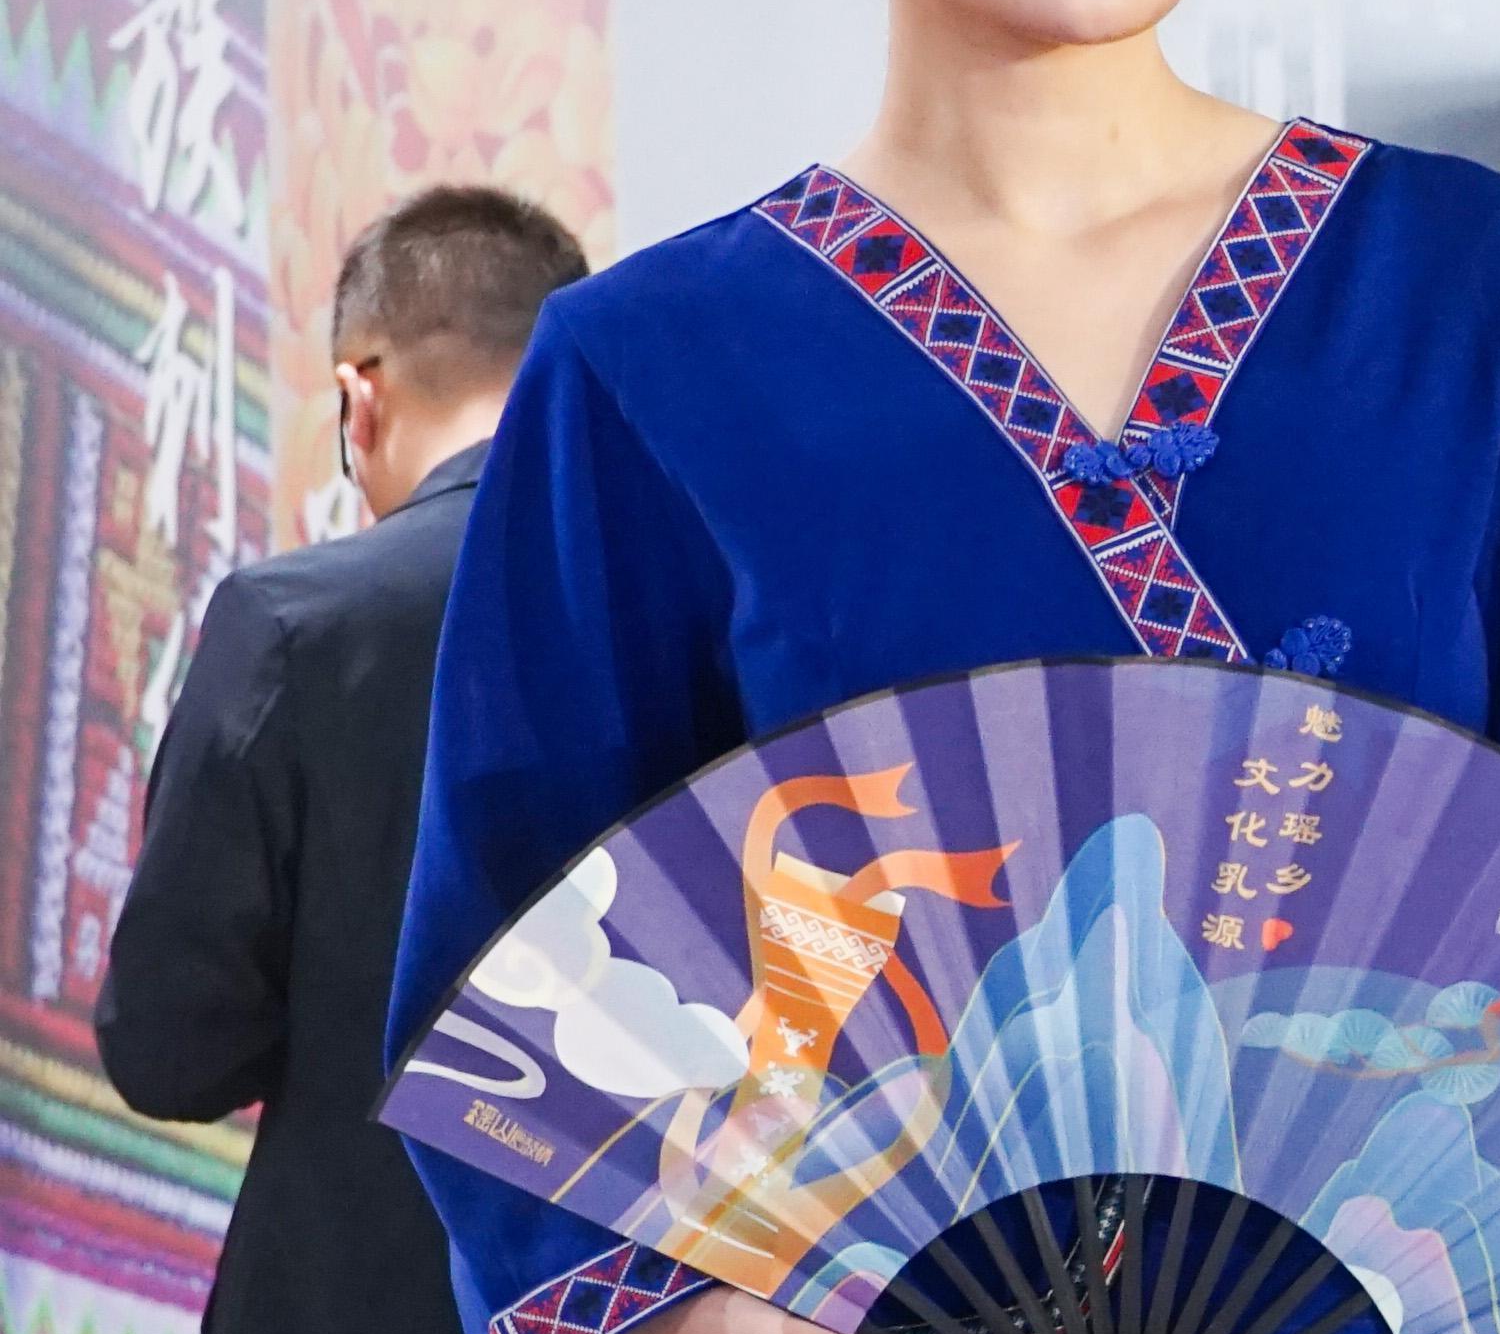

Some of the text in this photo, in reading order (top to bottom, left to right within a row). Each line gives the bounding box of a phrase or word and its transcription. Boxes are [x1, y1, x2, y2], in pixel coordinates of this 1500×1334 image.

[1200, 756, 1282, 951] 文化乳源
[1265, 702, 1344, 895] 魅力瑶乡
